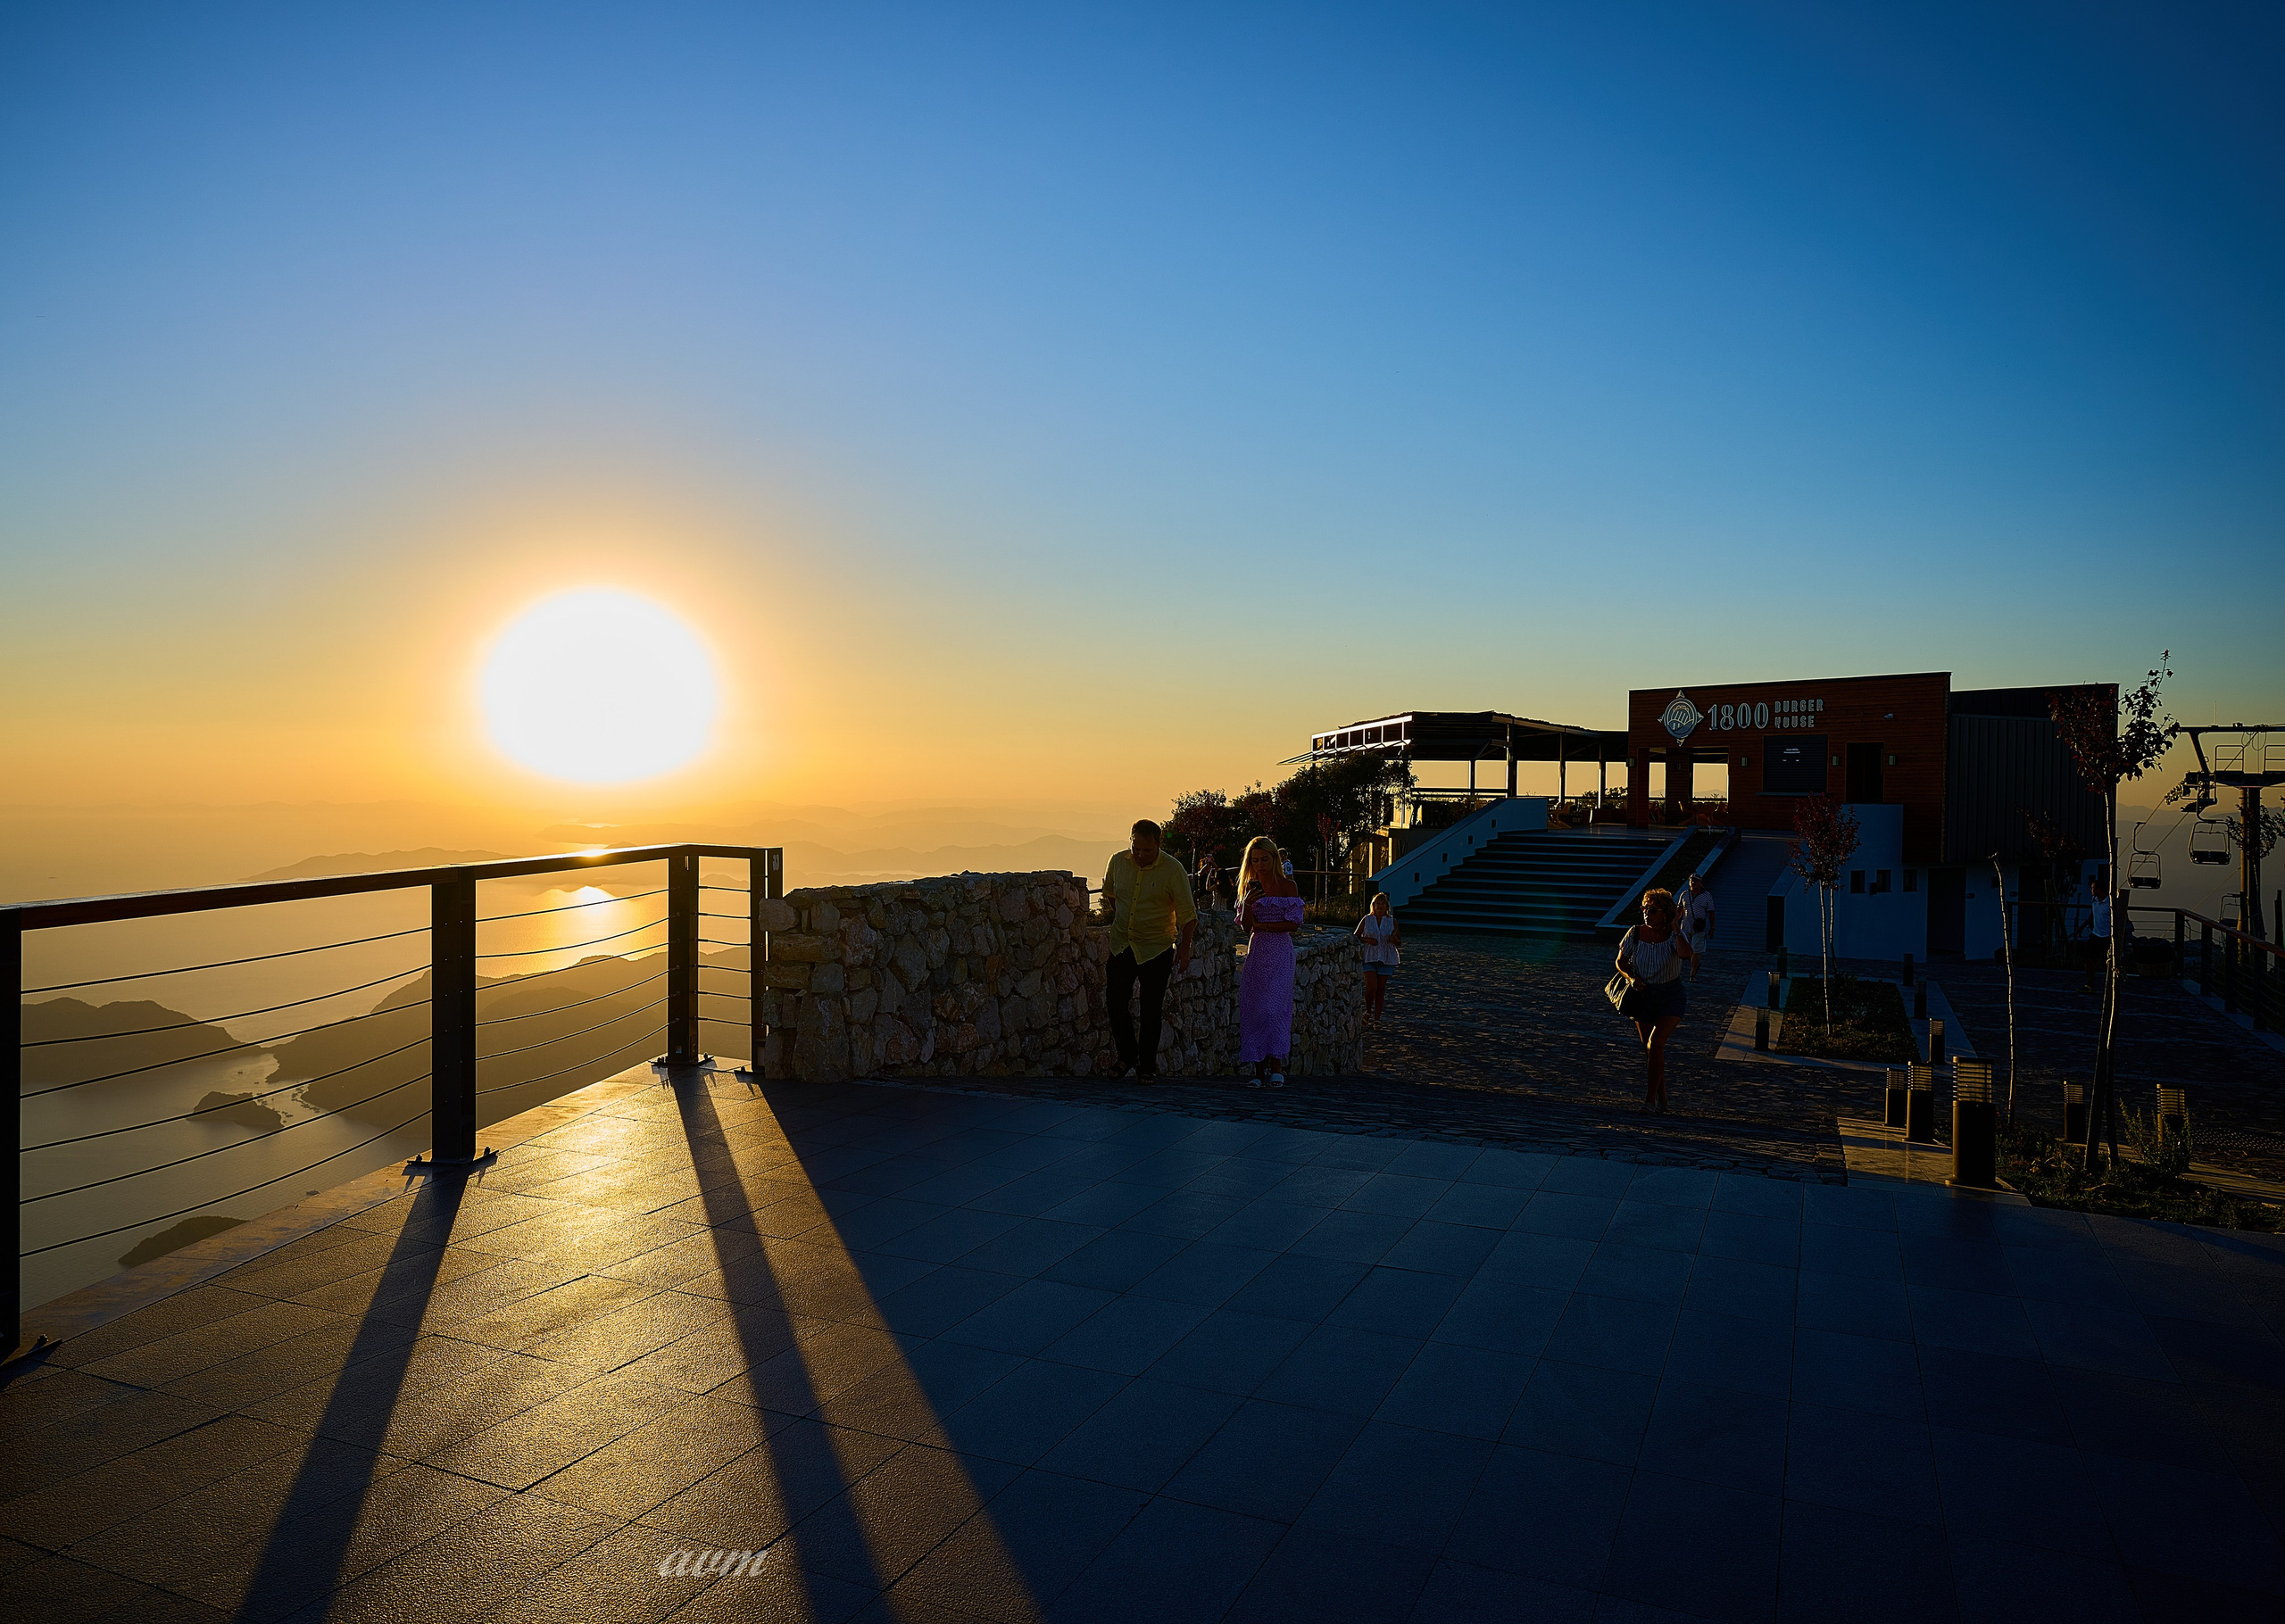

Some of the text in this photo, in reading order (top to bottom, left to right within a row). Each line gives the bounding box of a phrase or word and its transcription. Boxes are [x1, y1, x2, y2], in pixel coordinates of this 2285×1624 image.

[1774, 699, 1824, 714] BURGER
[1708, 701, 1769, 731] 1800
[1774, 716, 1815, 729] HOUSE
